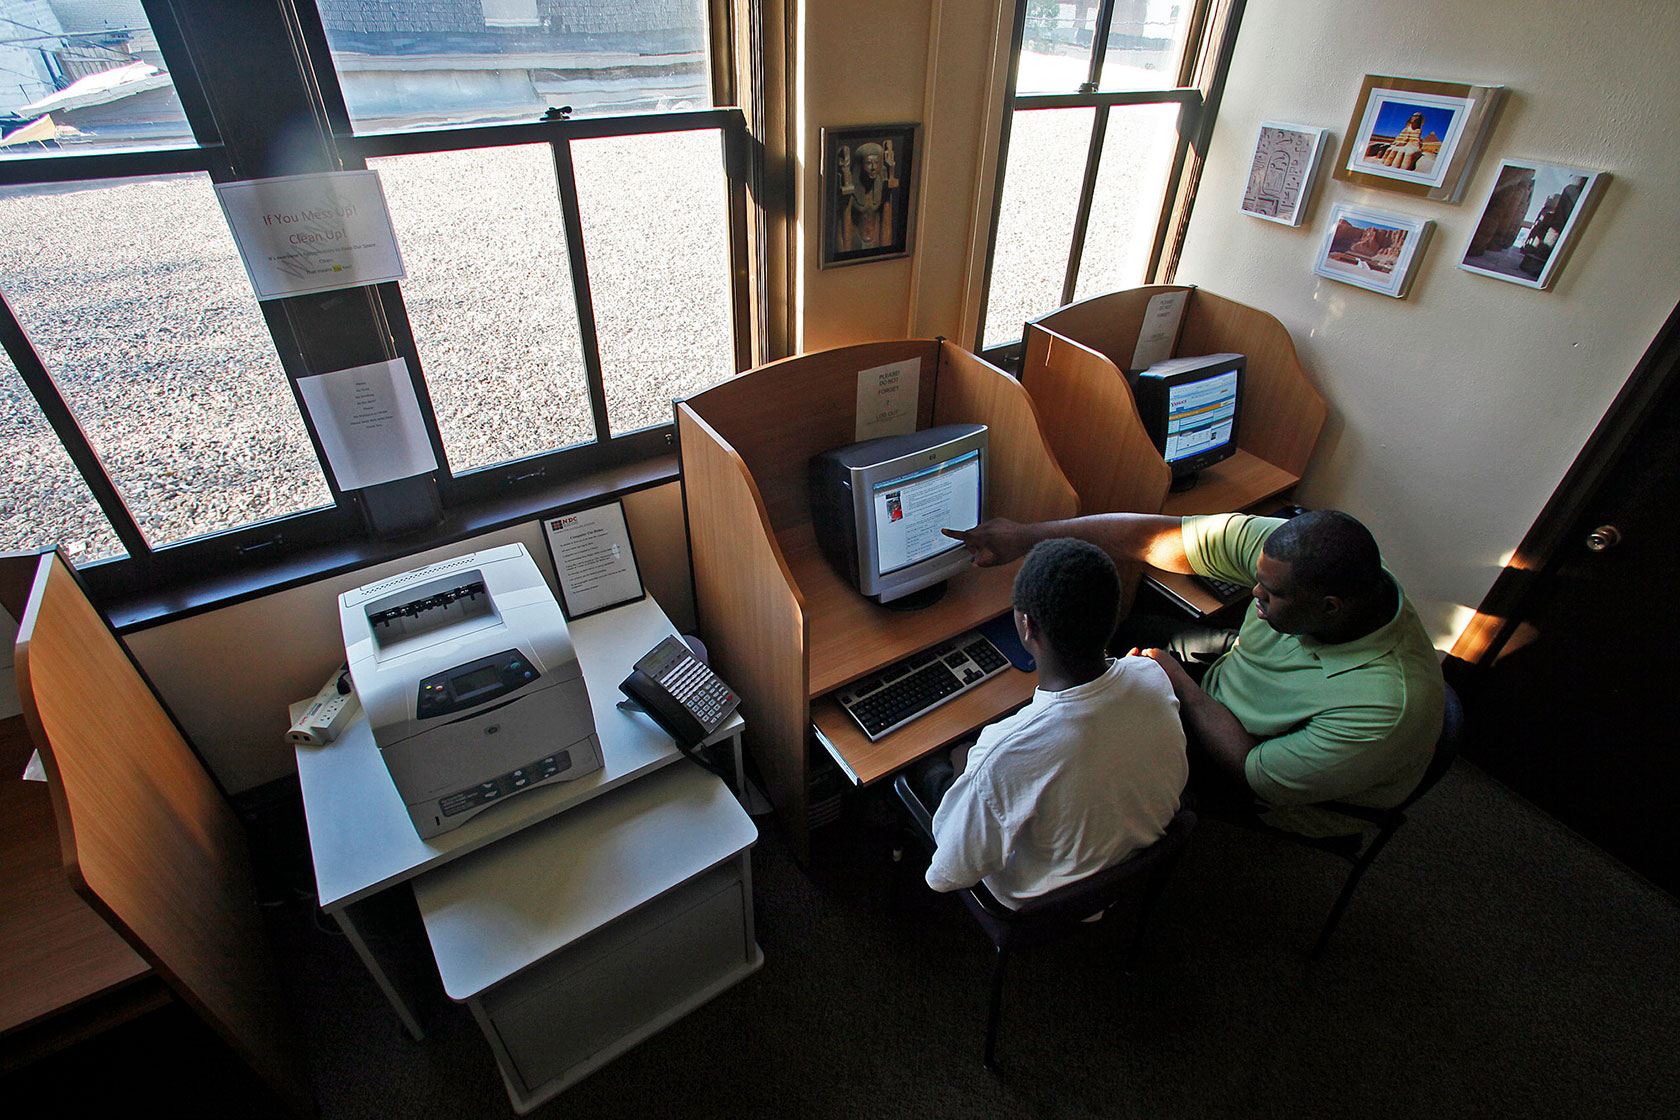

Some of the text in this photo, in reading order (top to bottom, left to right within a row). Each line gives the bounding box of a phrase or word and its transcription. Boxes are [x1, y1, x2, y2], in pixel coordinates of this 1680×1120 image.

[263, 204, 358, 226] If You Mess Up!
[289, 228, 348, 245] Clean Up!
[562, 516, 577, 524] NDC
